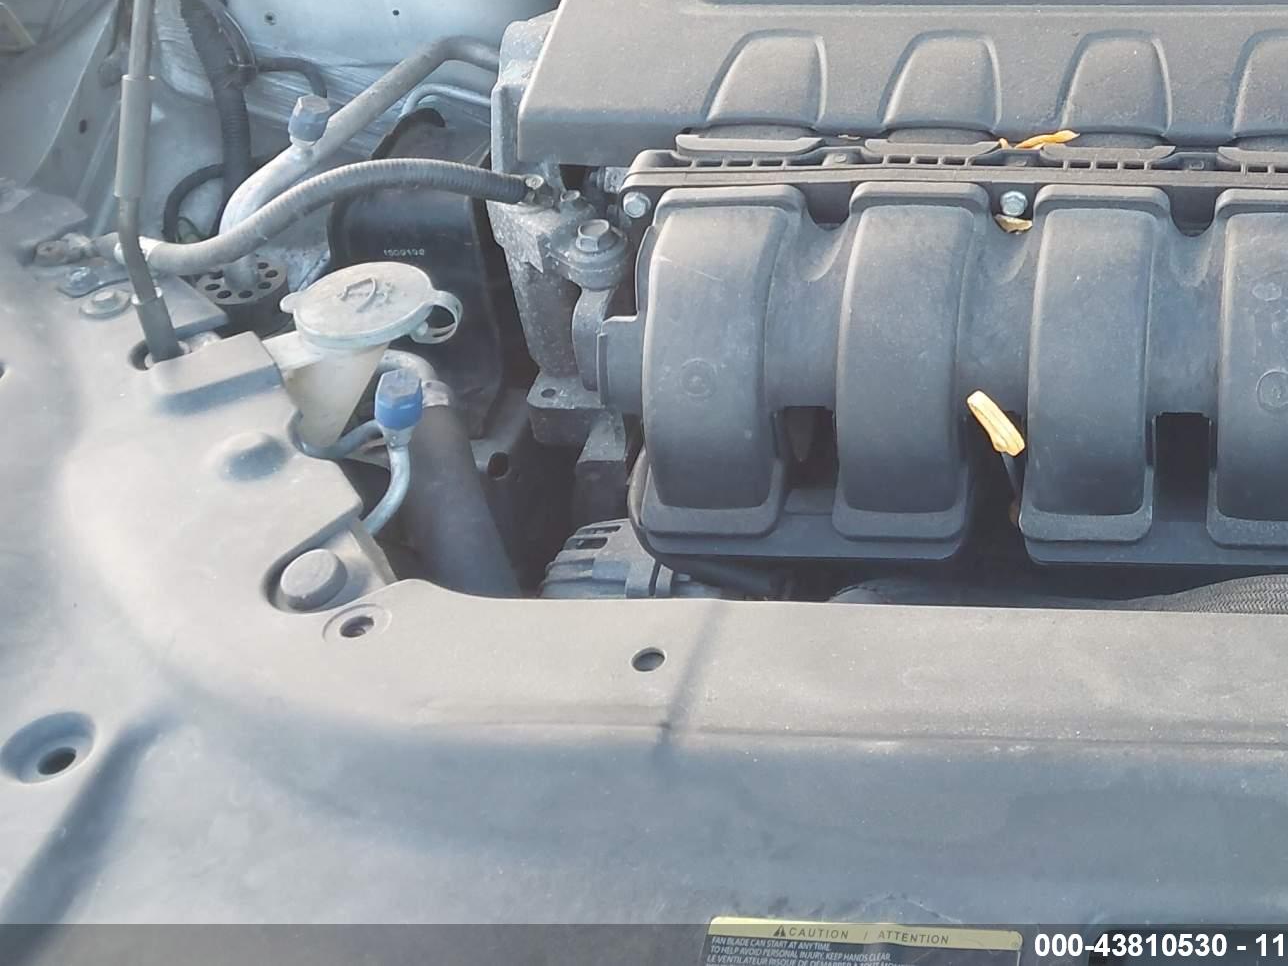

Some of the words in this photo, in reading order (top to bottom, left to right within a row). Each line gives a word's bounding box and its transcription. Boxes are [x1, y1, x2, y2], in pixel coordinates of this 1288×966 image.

[711, 936, 727, 945] FAN
[726, 937, 750, 947] BLADE
[750, 938, 766, 947] CAN
[766, 939, 788, 948] START
[789, 927, 849, 940] CAUTION
[878, 929, 949, 945] ATTENTION
[710, 945, 720, 954] TO
[720, 946, 740, 955] HELP
[740, 947, 762, 956] AVOID
[761, 948, 798, 959] PERSONAL
[825, 952, 843, 961] KEEP
[843, 953, 868, 962] HANDS
